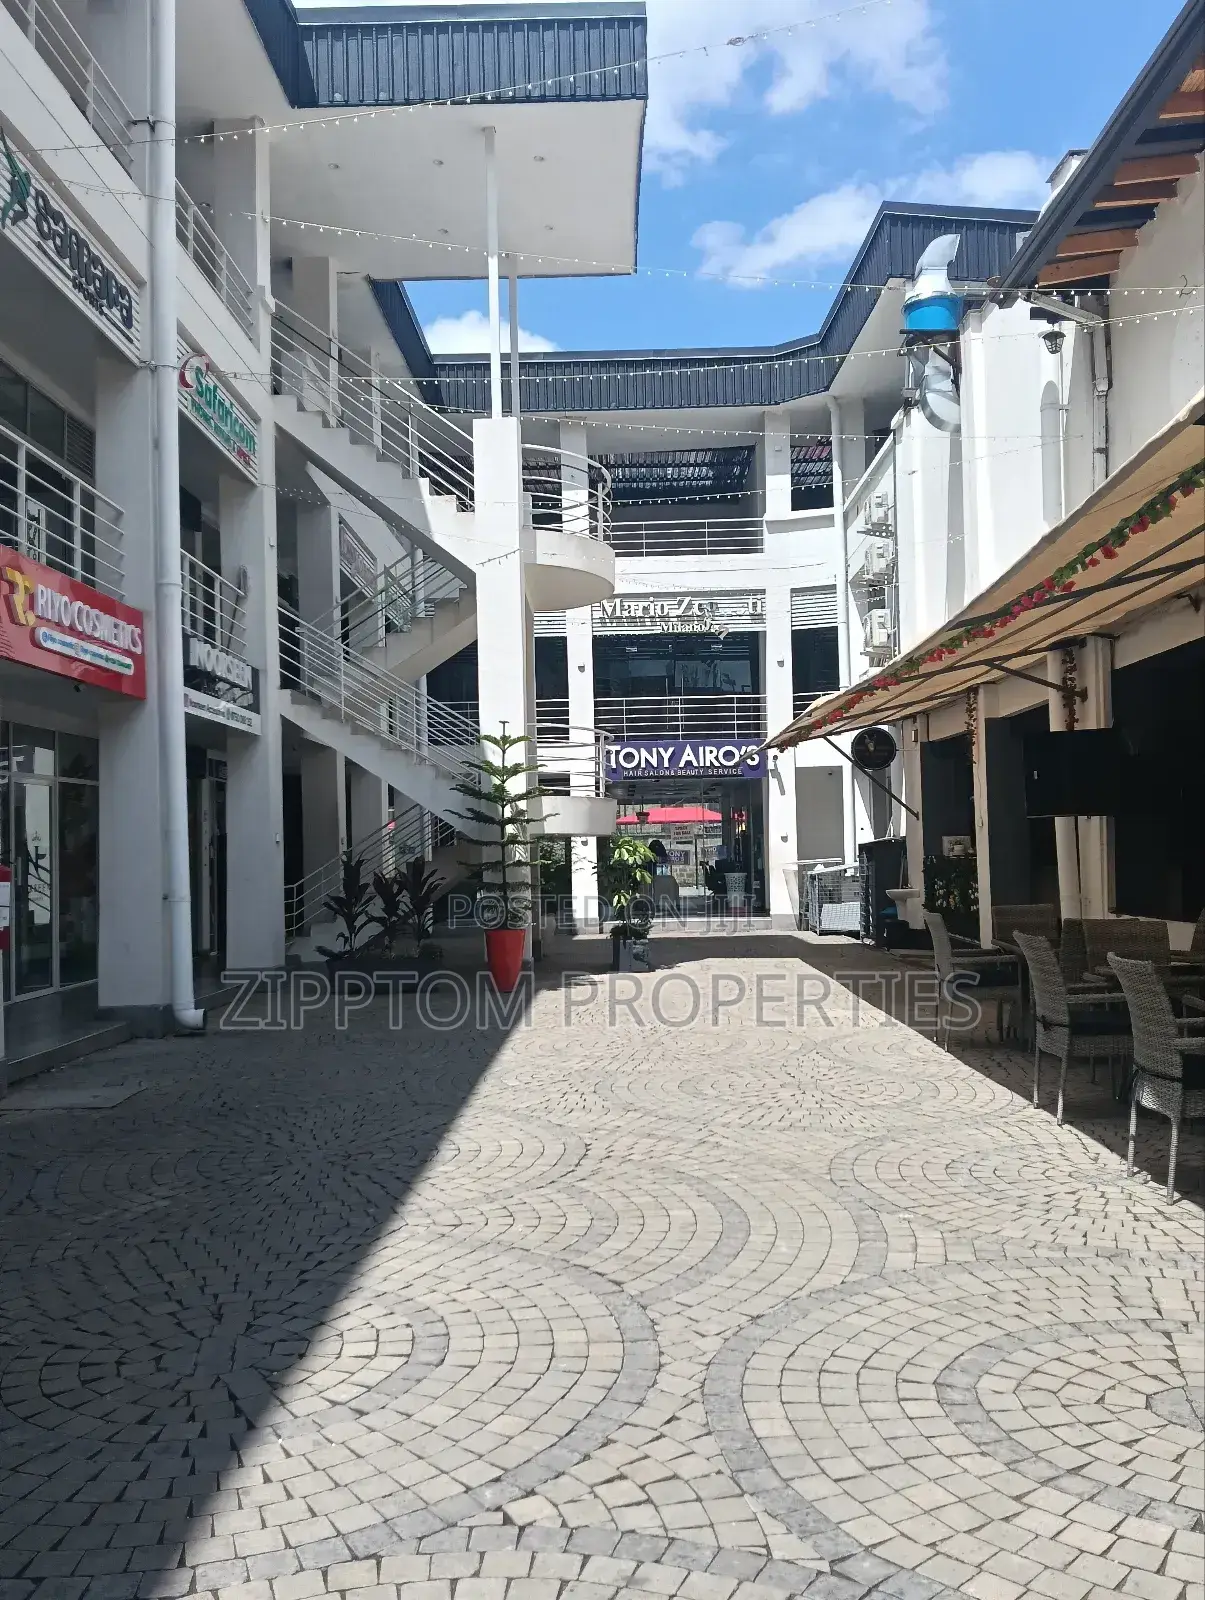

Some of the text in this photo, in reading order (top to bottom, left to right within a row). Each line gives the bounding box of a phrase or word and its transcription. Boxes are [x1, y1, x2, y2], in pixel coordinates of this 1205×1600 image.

[194, 365, 256, 457] Safaricom
[600, 595, 669, 618] Mario
[35, 583, 142, 655] RIYO COSMETICS
[659, 621, 705, 632] Milano
[605, 744, 760, 769] TONY AIRO'S
[677, 768, 704, 776] BEAUTY
